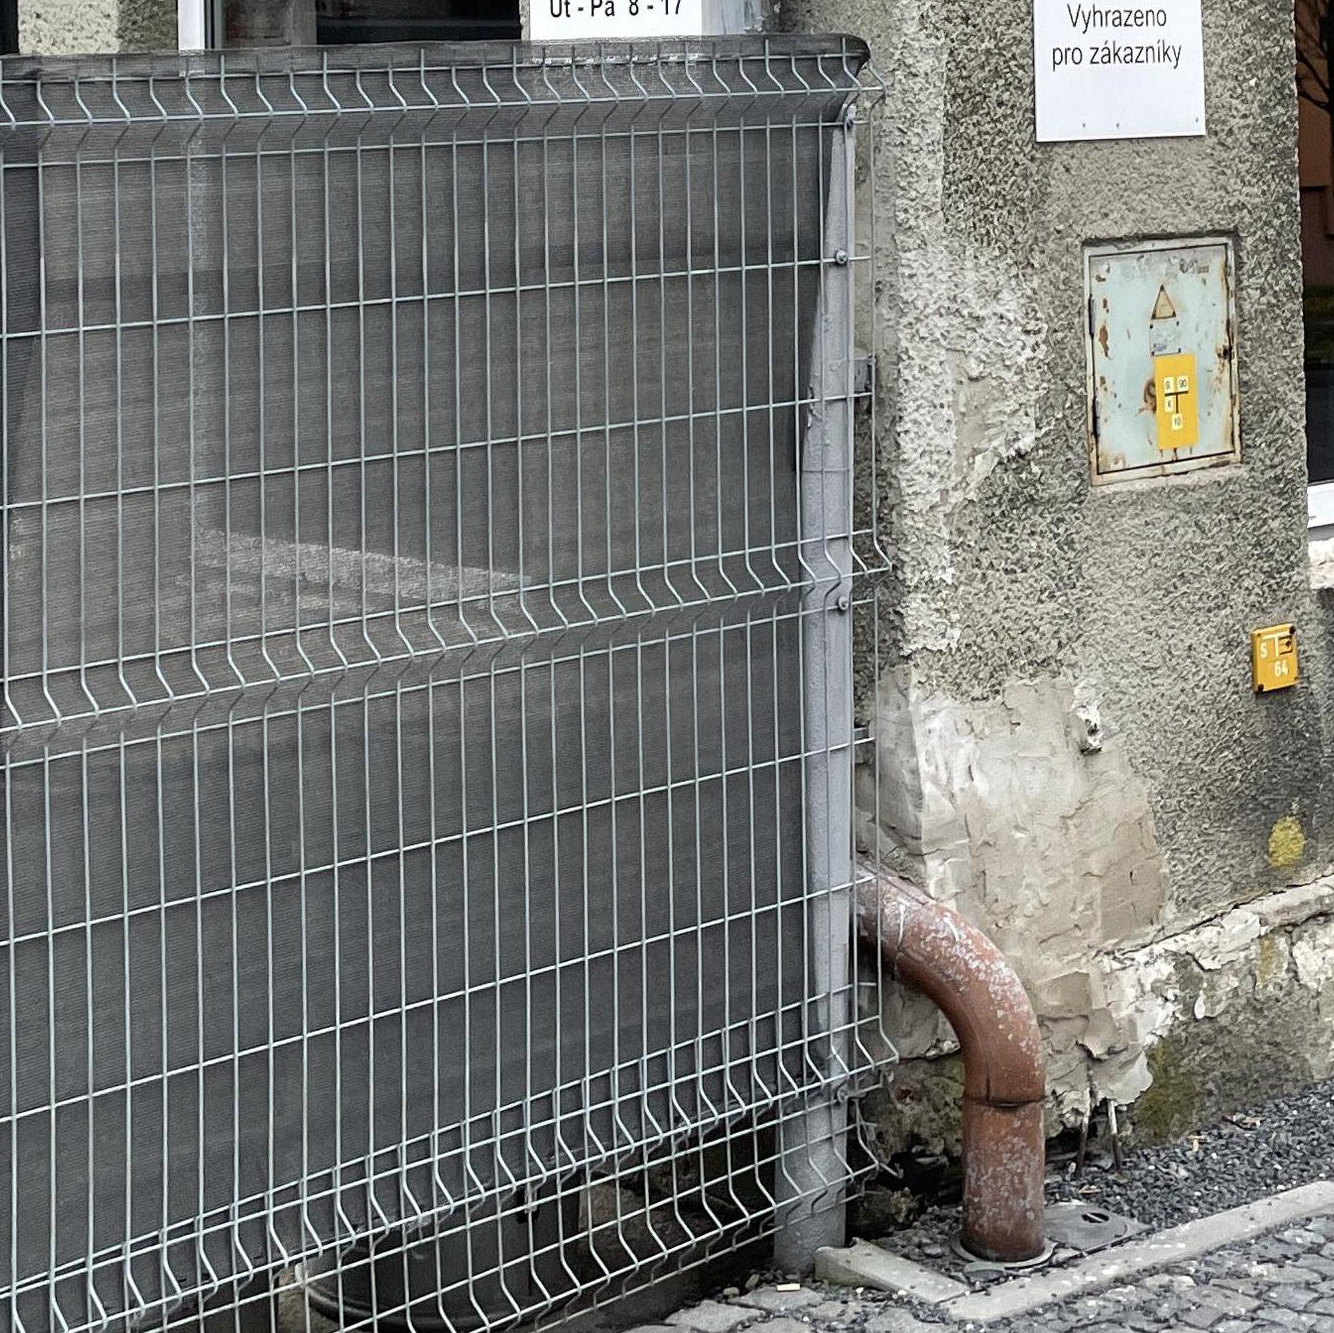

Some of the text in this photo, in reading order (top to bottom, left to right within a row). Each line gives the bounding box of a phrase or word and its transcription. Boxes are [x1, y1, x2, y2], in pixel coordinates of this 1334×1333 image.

[1067, 3, 1168, 34] Vyhrazeno
[1052, 39, 1182, 71] pro zákazníky
